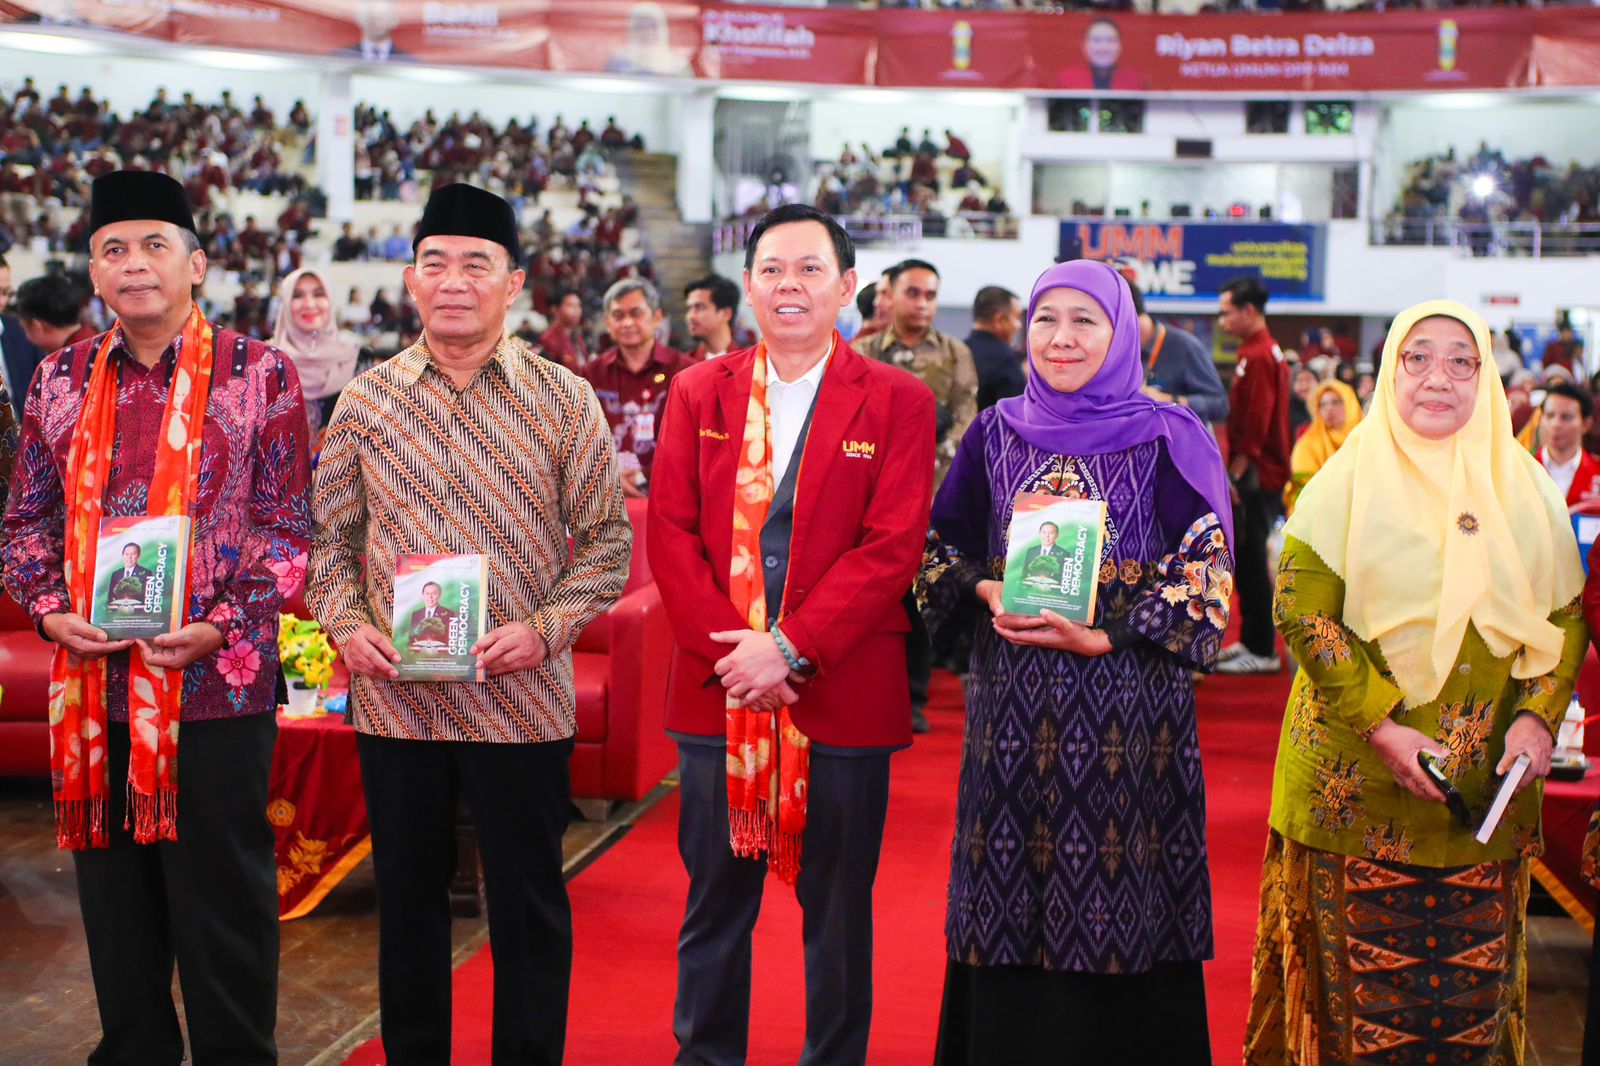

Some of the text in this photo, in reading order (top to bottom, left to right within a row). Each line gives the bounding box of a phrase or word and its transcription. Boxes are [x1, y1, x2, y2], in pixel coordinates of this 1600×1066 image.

[1078, 224, 1184, 260] UMM
[843, 440, 875, 455] UMM
[153, 542, 168, 613] DEMOCRACY
[1060, 557, 1074, 595] GREEN
[1070, 526, 1088, 596] DEMOCRACY
[144, 576, 155, 613] GREEN
[448, 617, 458, 655] GREEN
[458, 582, 470, 656] DEMOCRACY
